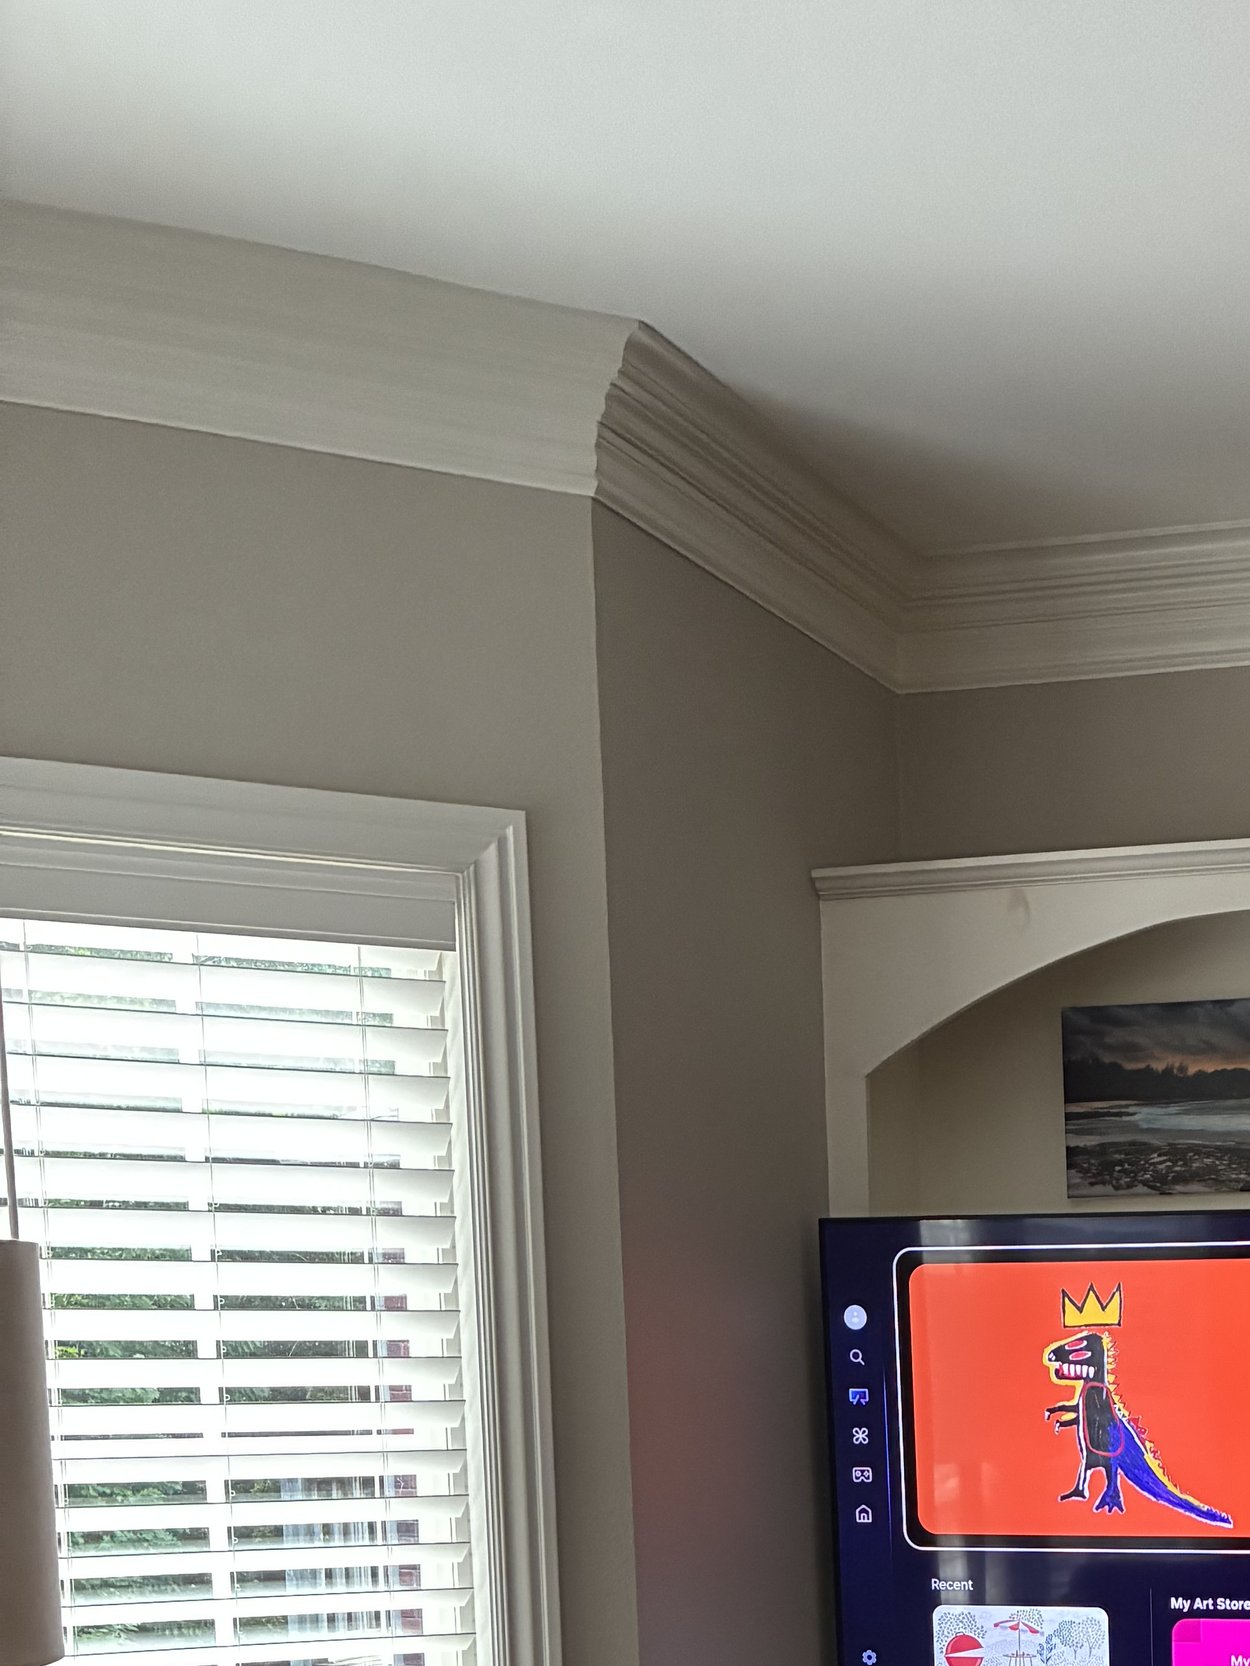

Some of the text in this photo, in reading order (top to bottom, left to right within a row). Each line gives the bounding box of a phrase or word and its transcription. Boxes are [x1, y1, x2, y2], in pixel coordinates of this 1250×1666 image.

[931, 1578, 974, 1592] Recent
[1170, 1597, 1191, 1612] My
[1193, 1597, 1214, 1611] Art
